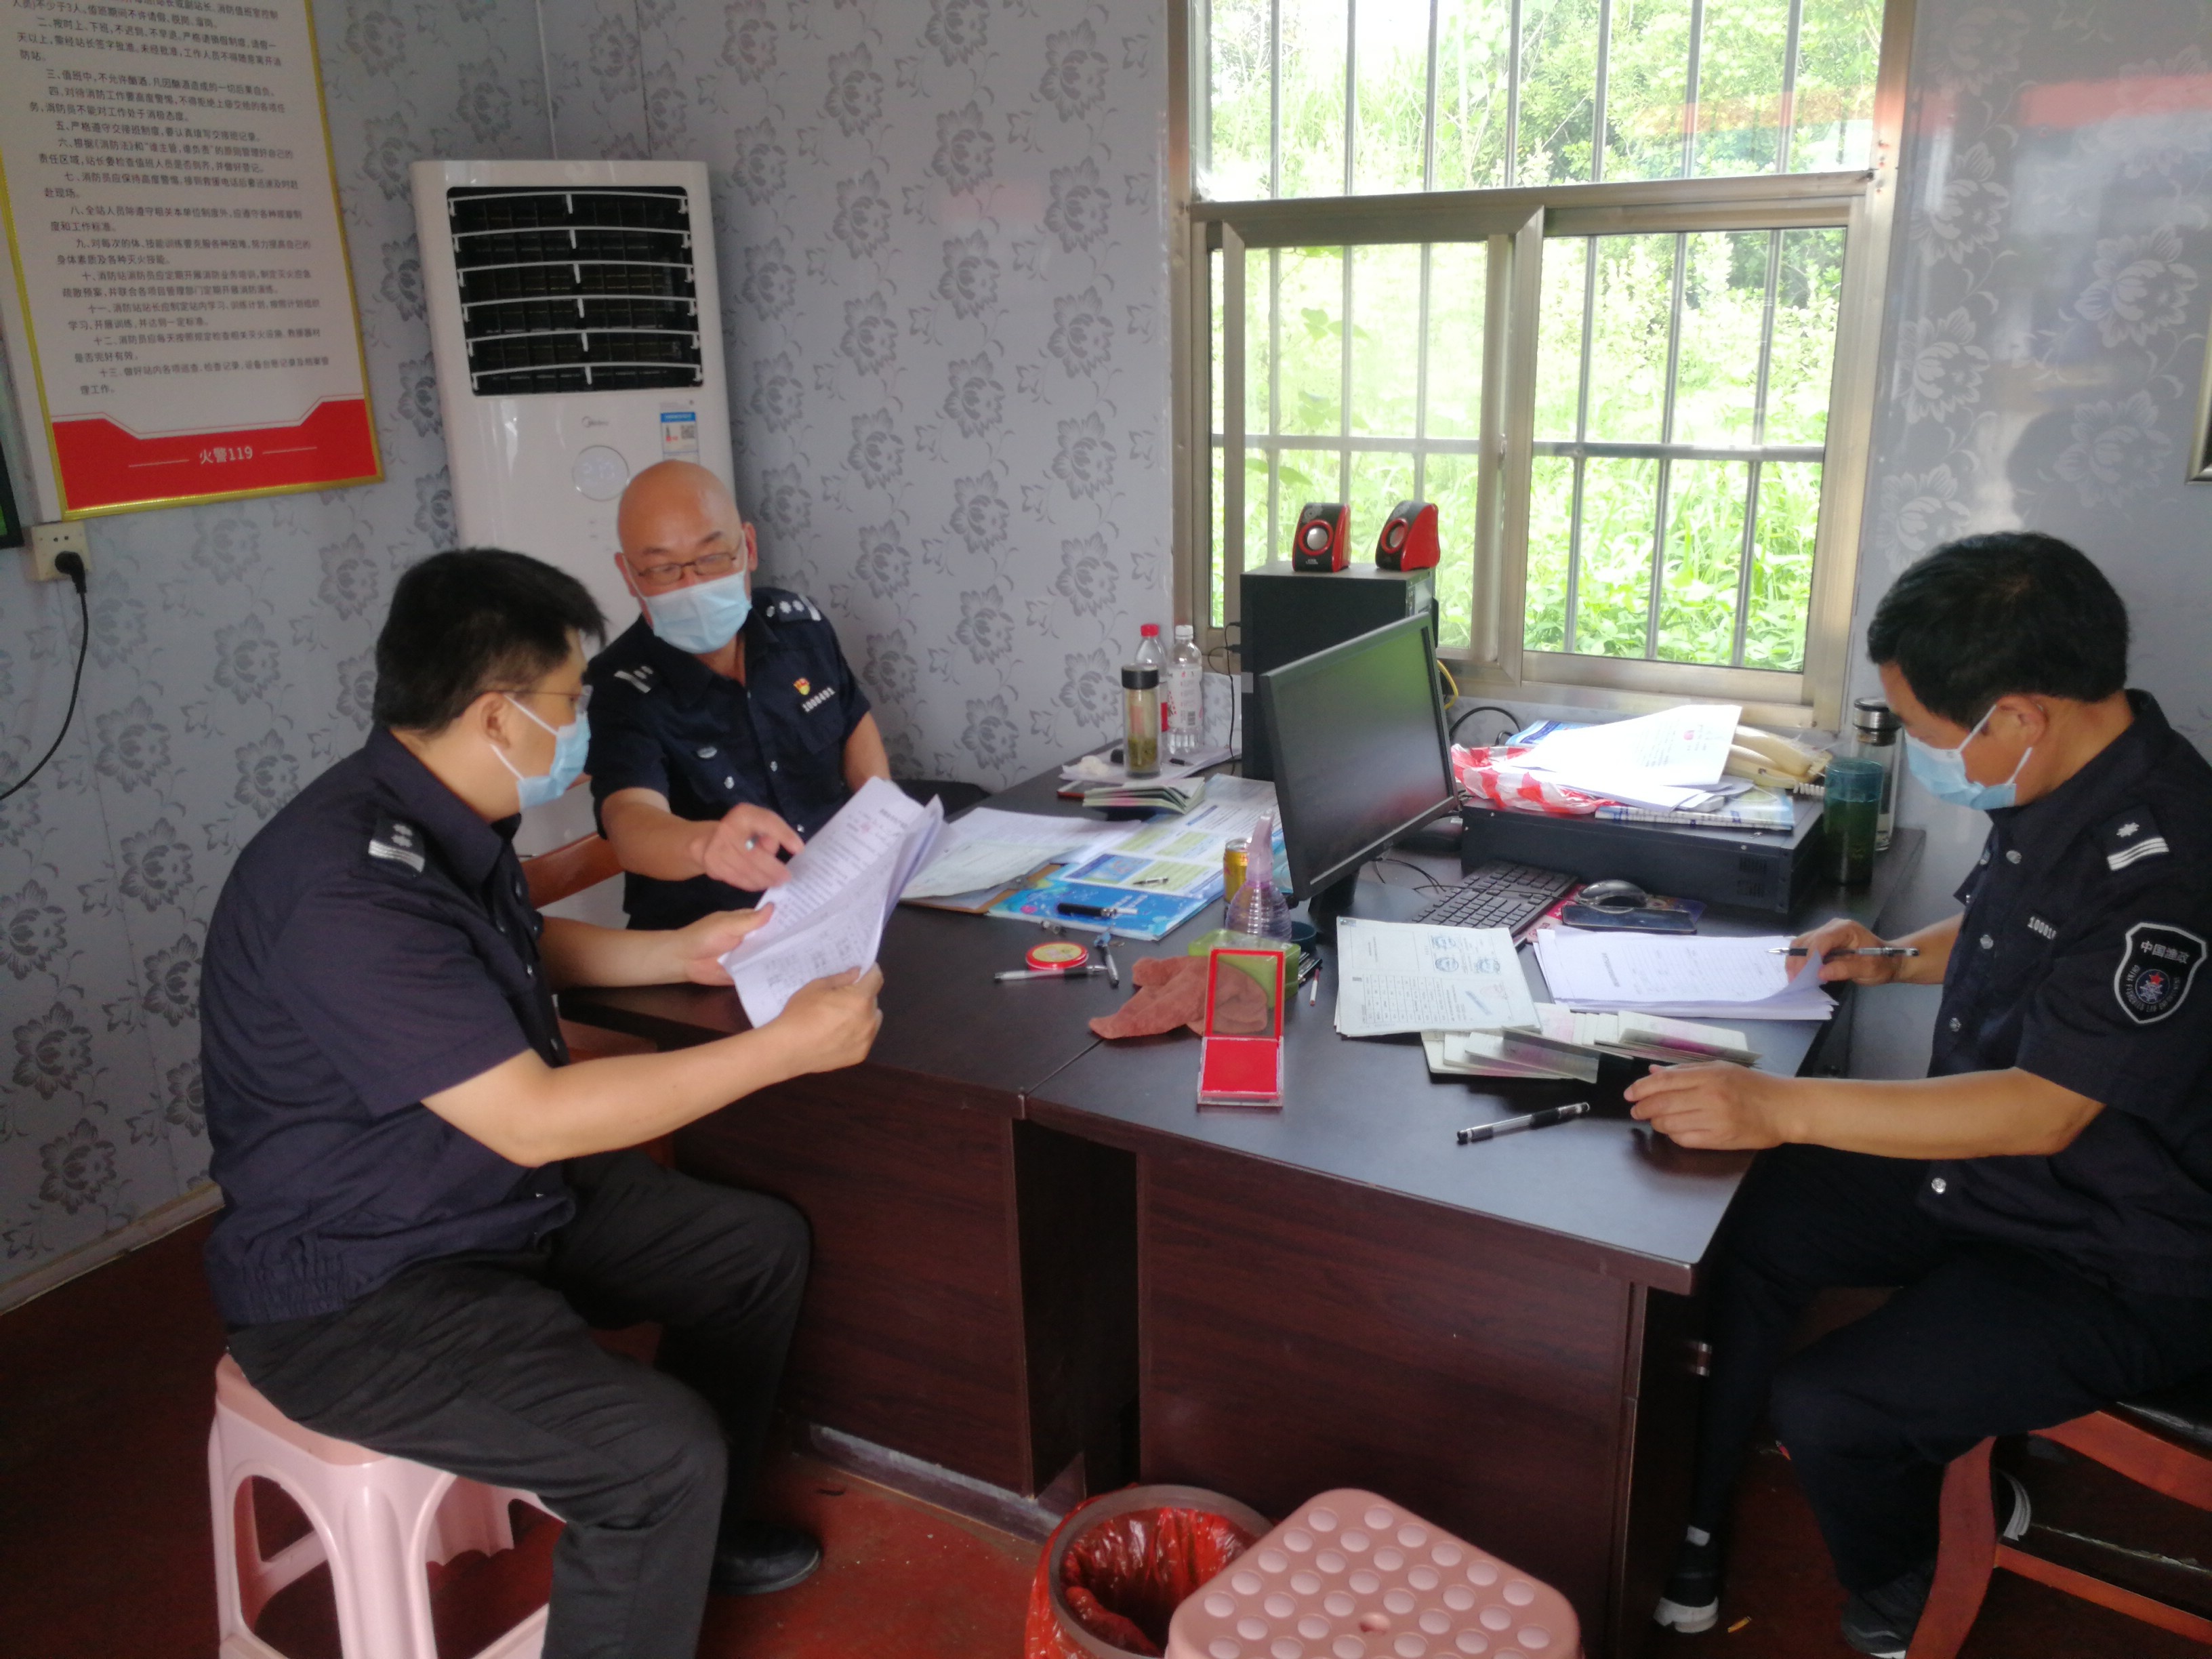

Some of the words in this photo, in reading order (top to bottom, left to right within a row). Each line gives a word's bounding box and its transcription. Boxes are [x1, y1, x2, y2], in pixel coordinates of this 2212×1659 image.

[199, 446, 253, 465] 火警119
[2140, 940, 2190, 964] 中国渔政
